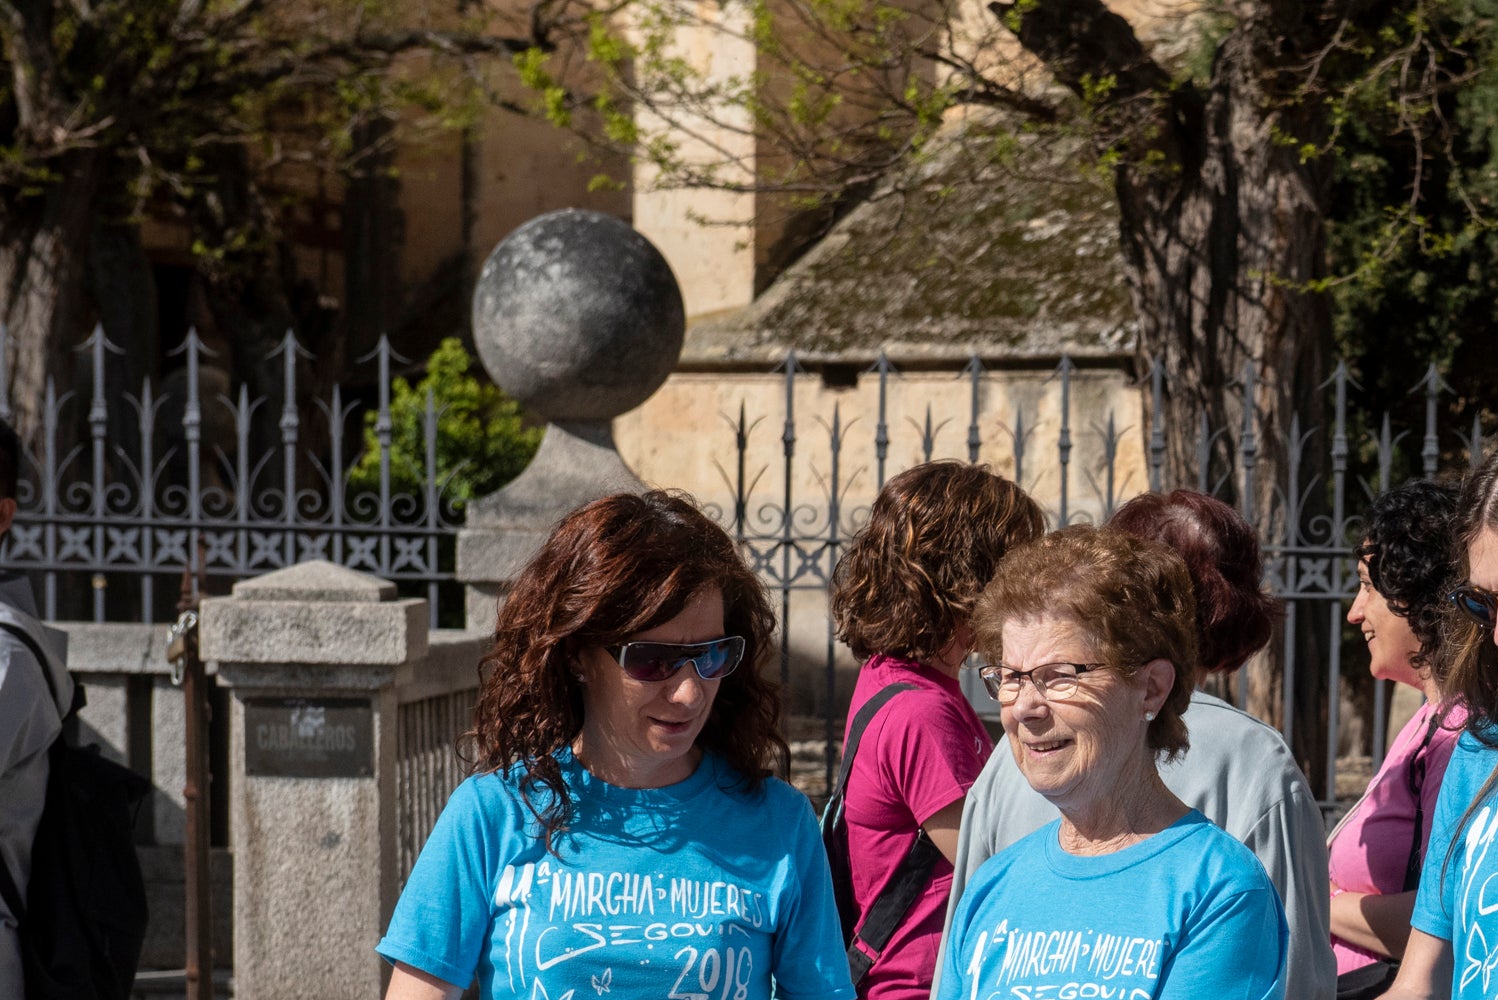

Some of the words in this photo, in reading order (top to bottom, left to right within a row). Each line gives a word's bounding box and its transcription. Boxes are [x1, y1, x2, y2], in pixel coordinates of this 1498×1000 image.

[549, 868, 655, 922] MARCHA
[670, 877, 763, 929] MUJERES
[996, 928, 1082, 987] MARCHA
[1088, 932, 1162, 981] MUJERE
